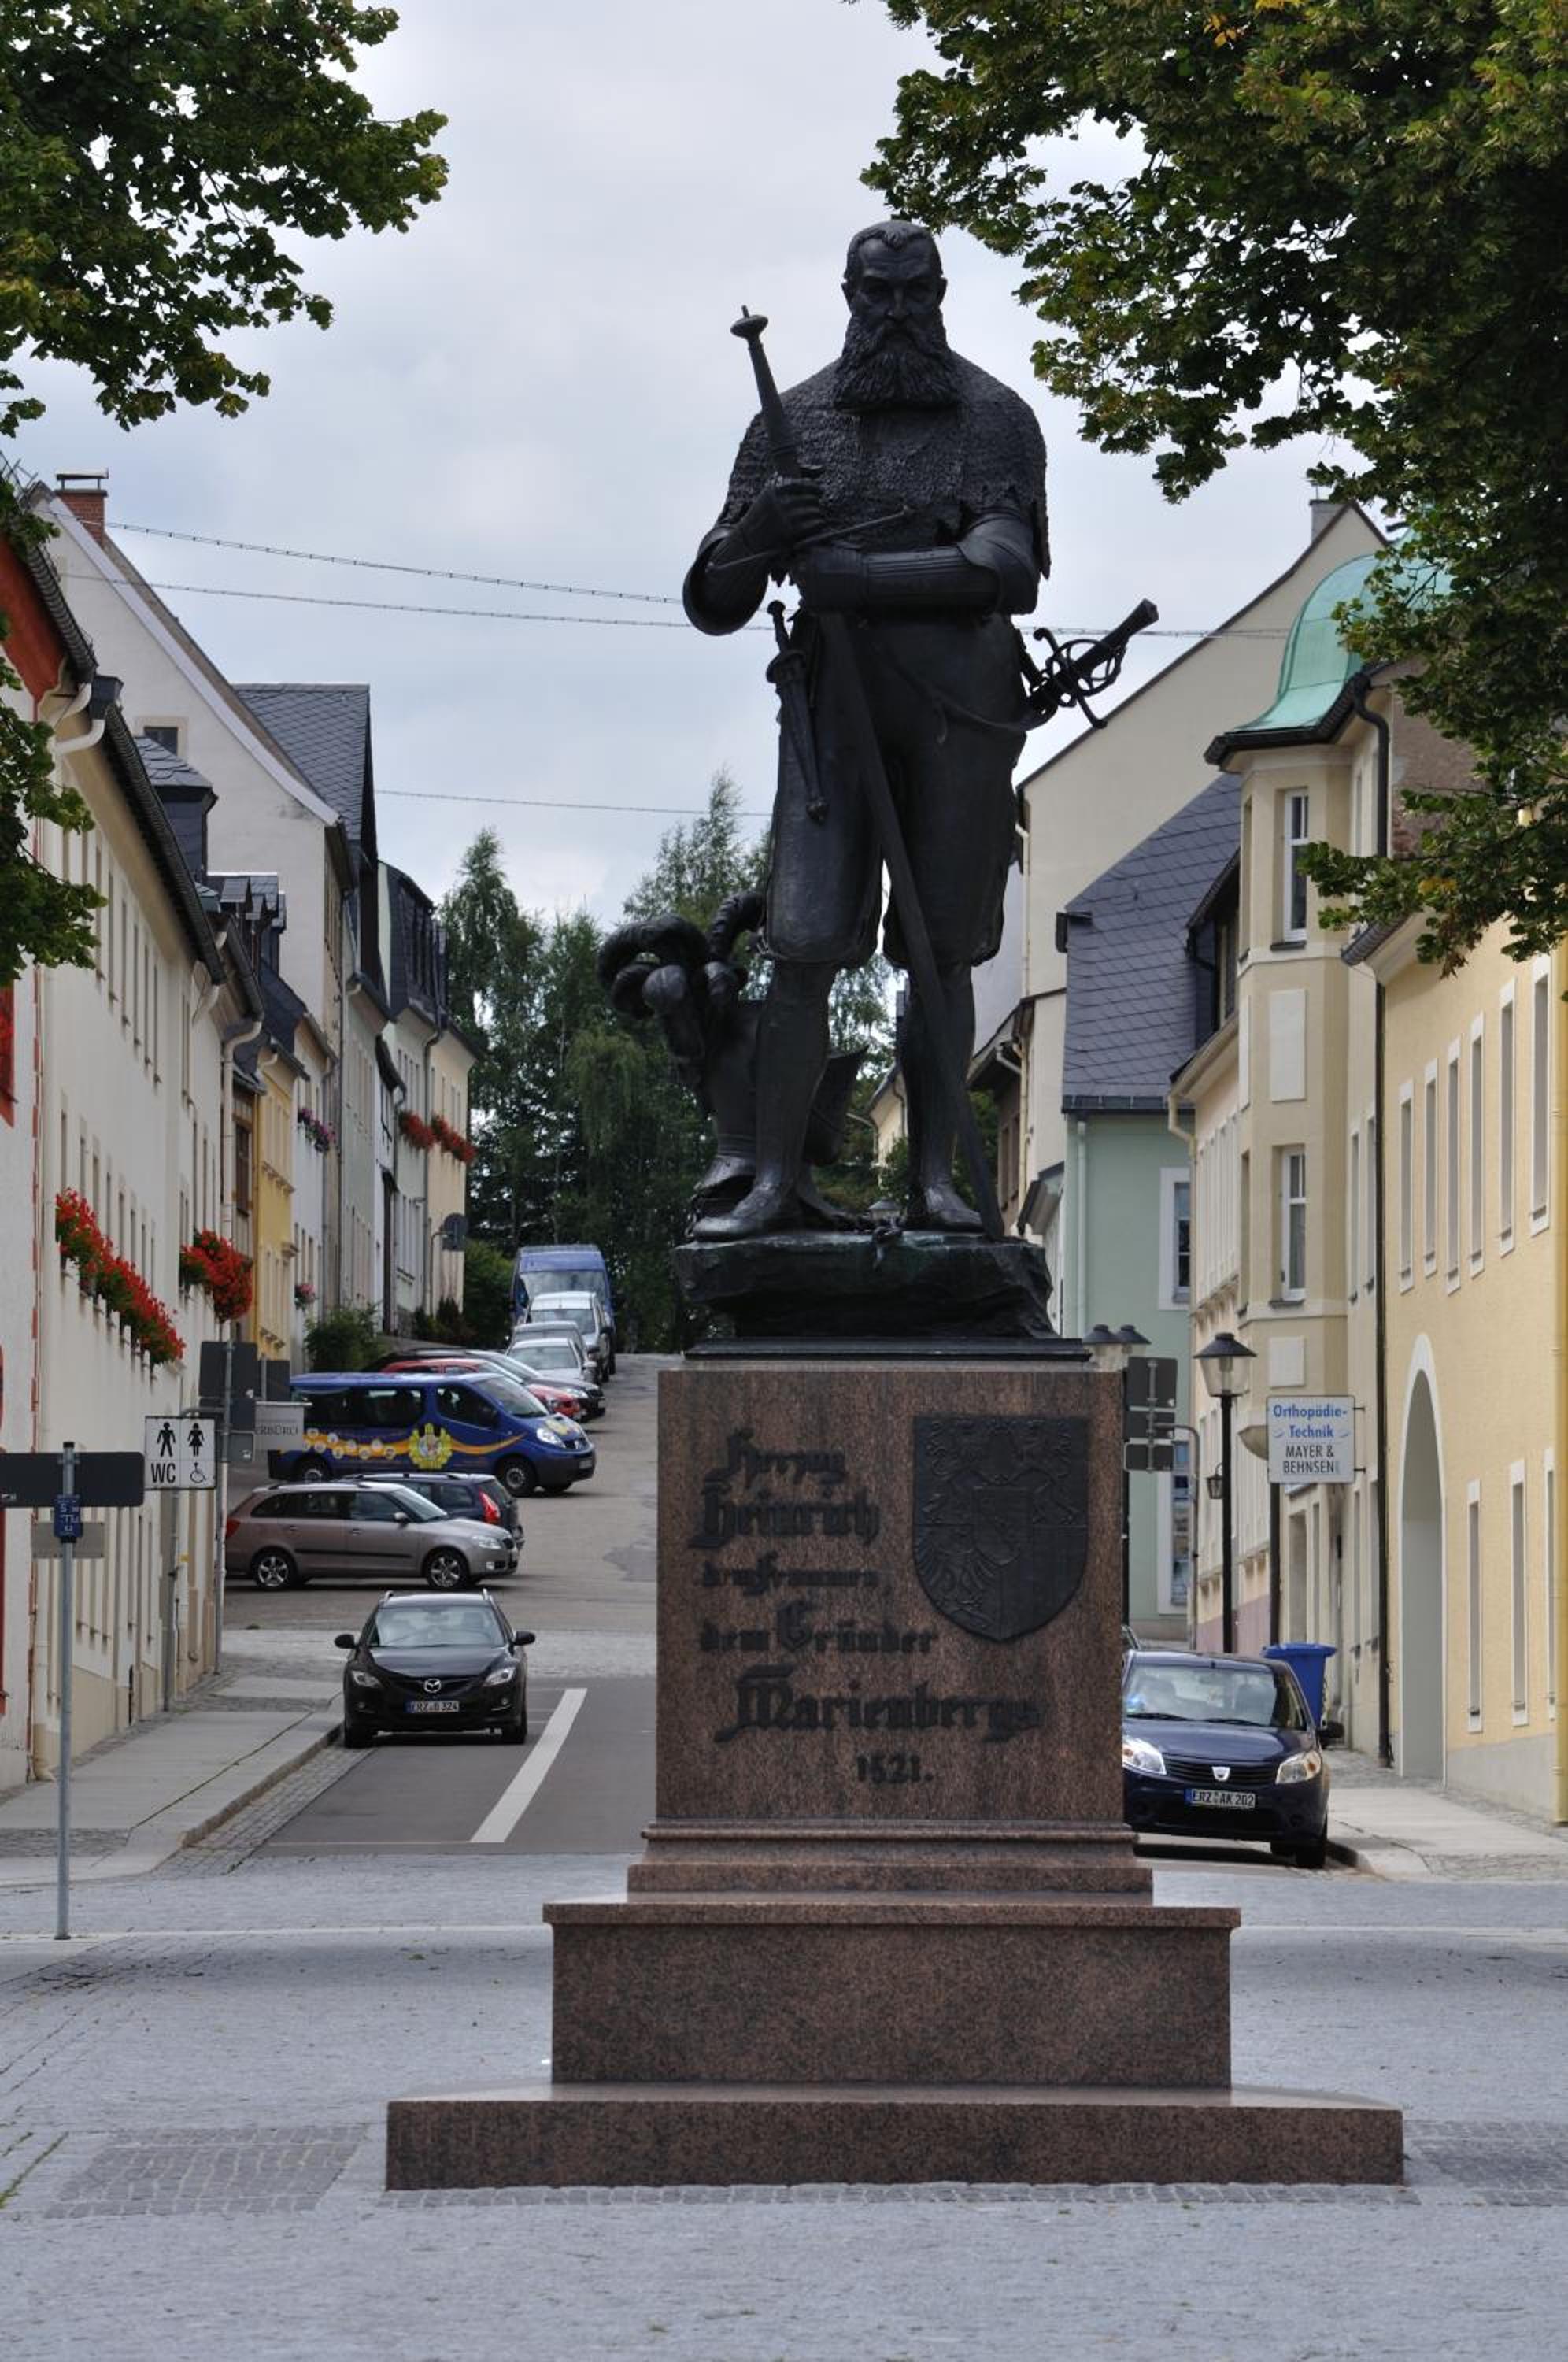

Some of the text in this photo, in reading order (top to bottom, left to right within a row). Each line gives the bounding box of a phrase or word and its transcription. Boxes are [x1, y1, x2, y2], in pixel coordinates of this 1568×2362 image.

[1289, 1424, 1335, 1438] Technik
[1285, 1445, 1334, 1457] MAYER &
[150, 1462, 176, 1483] WC
[1282, 1461, 1334, 1473] BEHNSEN
